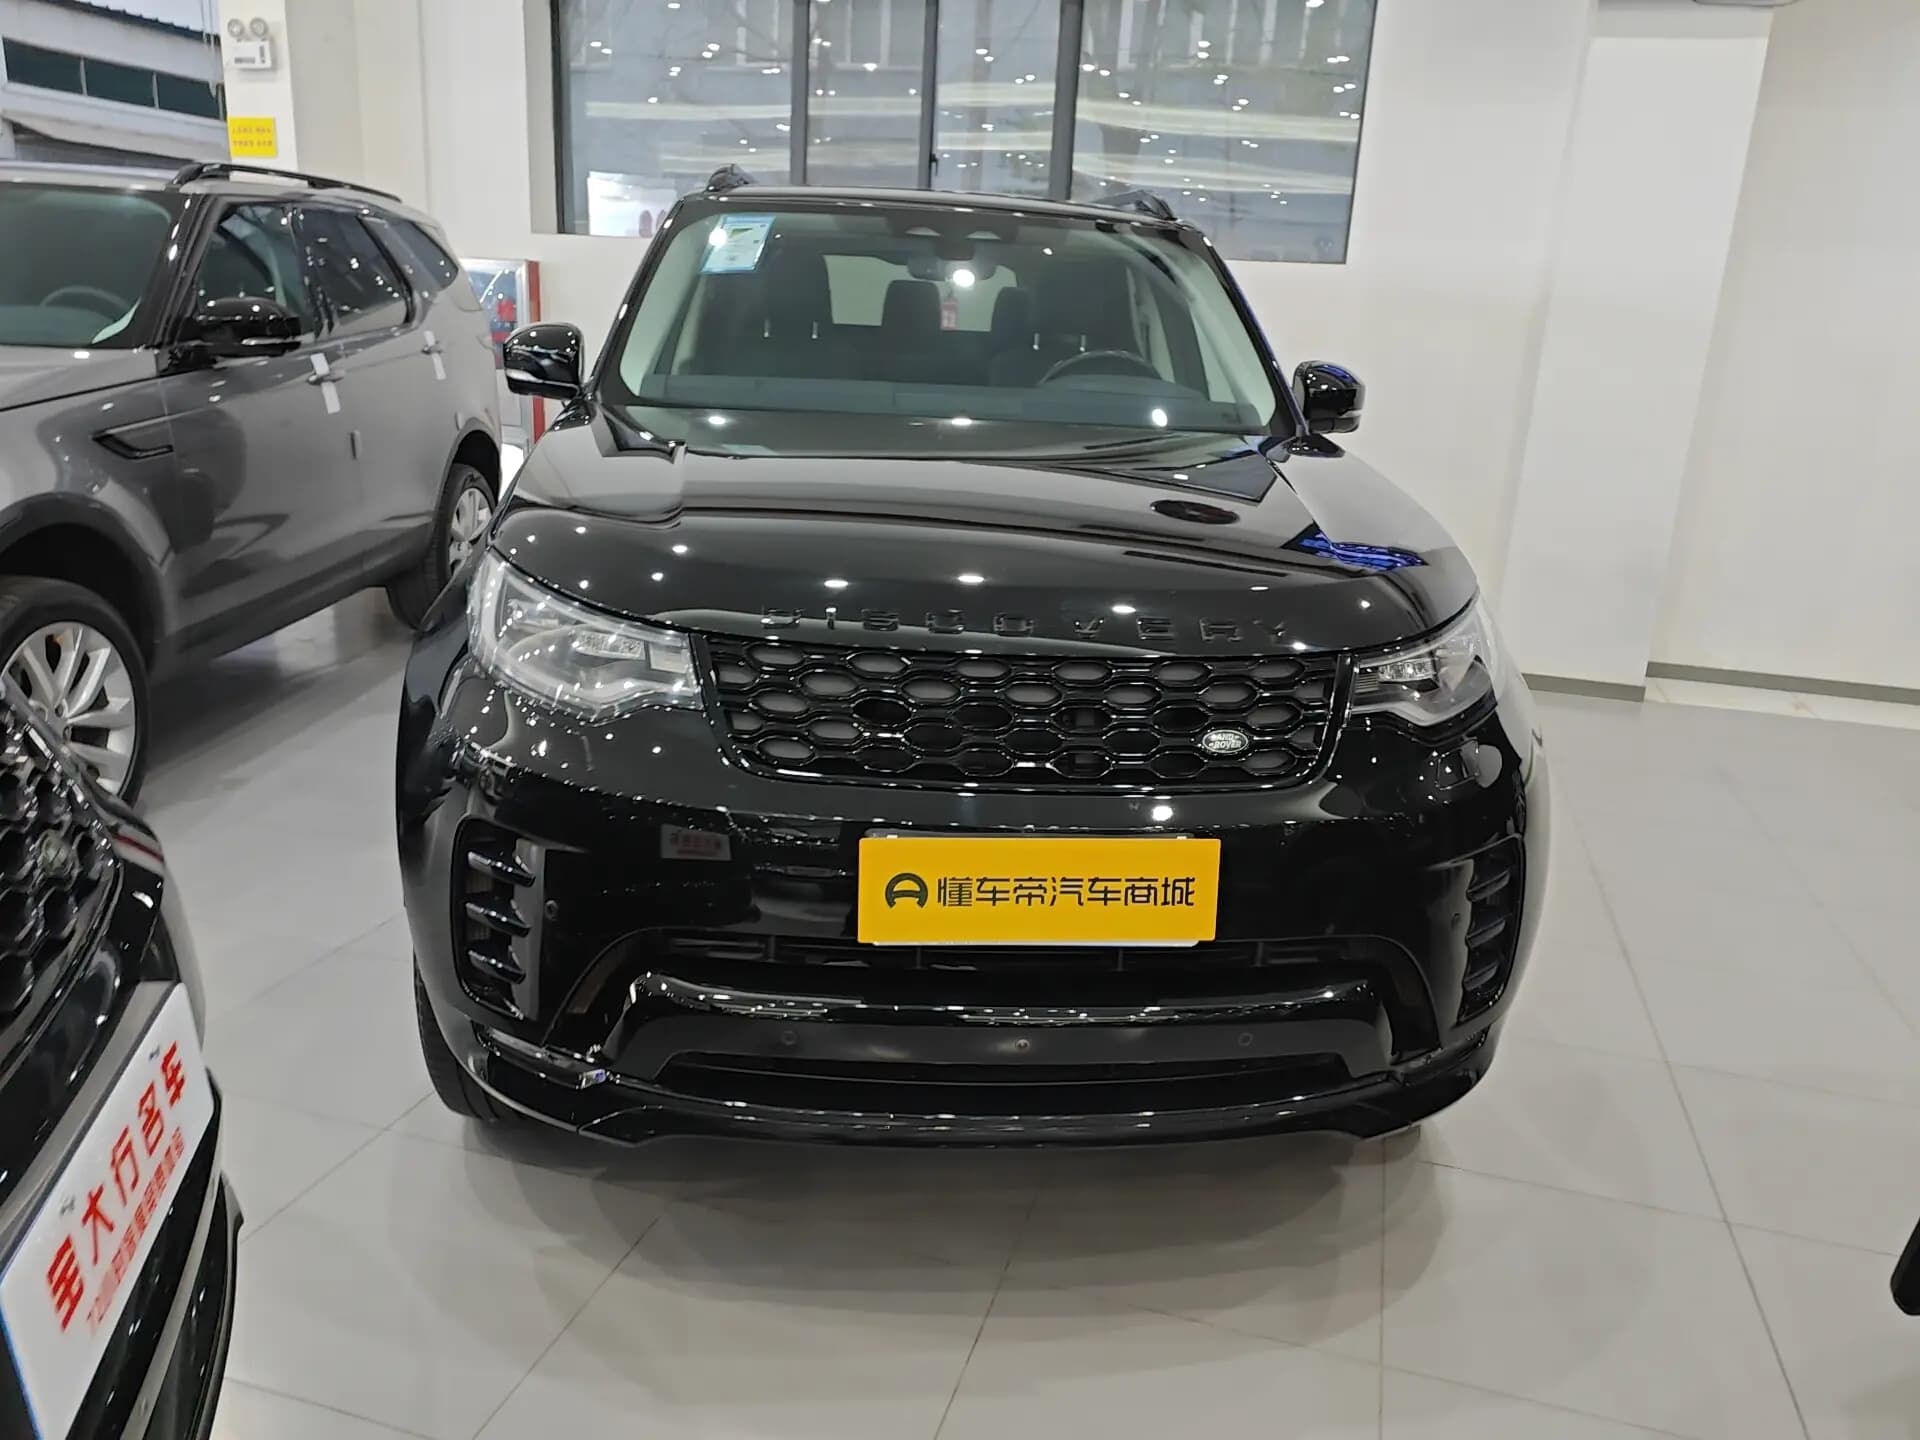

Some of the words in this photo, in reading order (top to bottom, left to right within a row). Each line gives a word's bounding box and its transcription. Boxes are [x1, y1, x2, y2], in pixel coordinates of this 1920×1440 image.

[761, 606, 1290, 641] DISCOVERY
[1213, 740, 1242, 749] ROVER
[937, 876, 1196, 907] 懂车帝汽车商城
